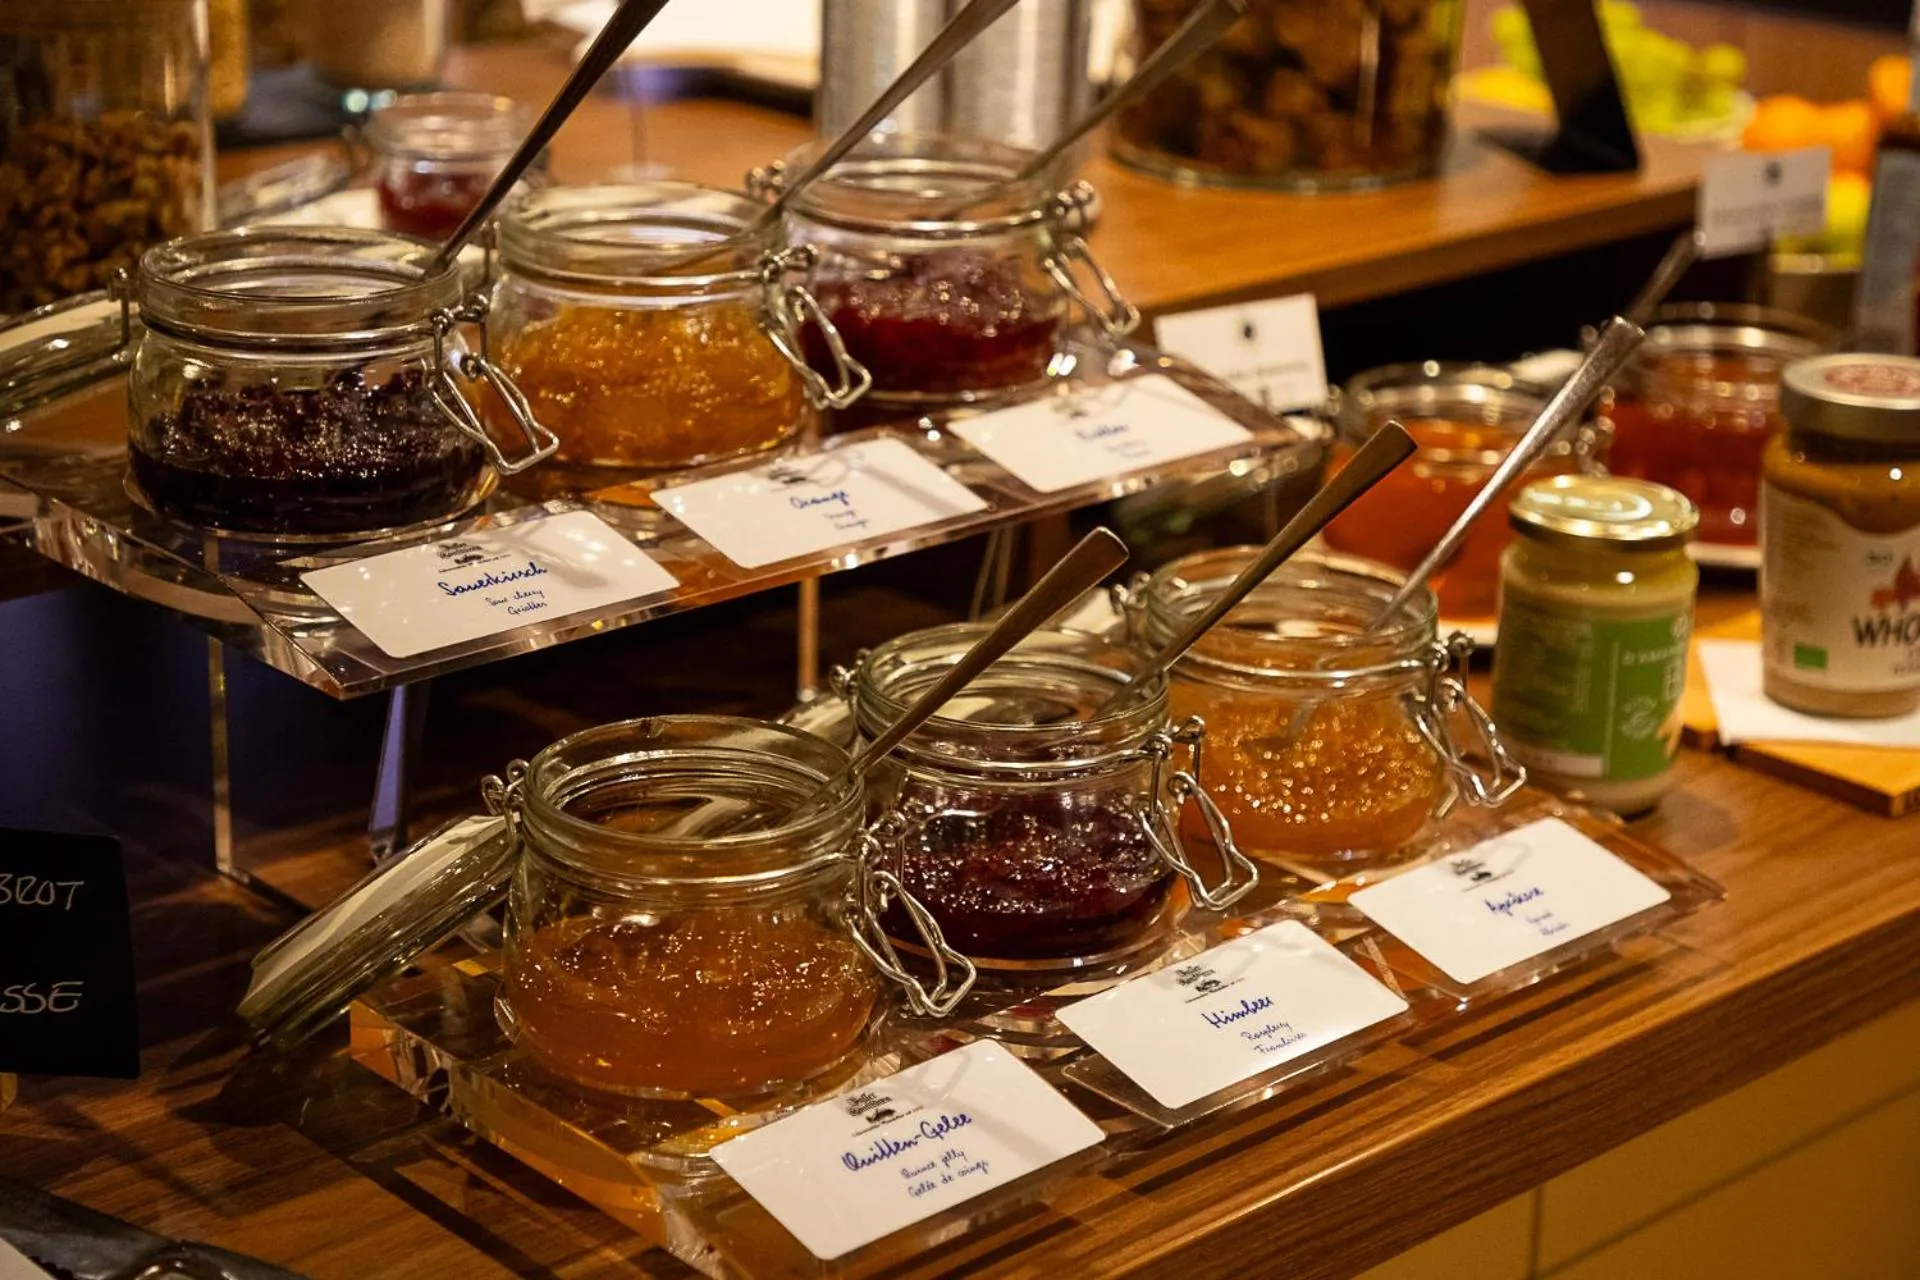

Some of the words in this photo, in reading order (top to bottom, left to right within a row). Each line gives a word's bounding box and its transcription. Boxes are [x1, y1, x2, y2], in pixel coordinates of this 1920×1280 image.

[438, 561, 548, 596] Sauerkirsch
[1201, 996, 1275, 1029] Himbeer
[841, 1113, 973, 1172] Quitten-Gelee
[941, 1172, 955, 1185] de
